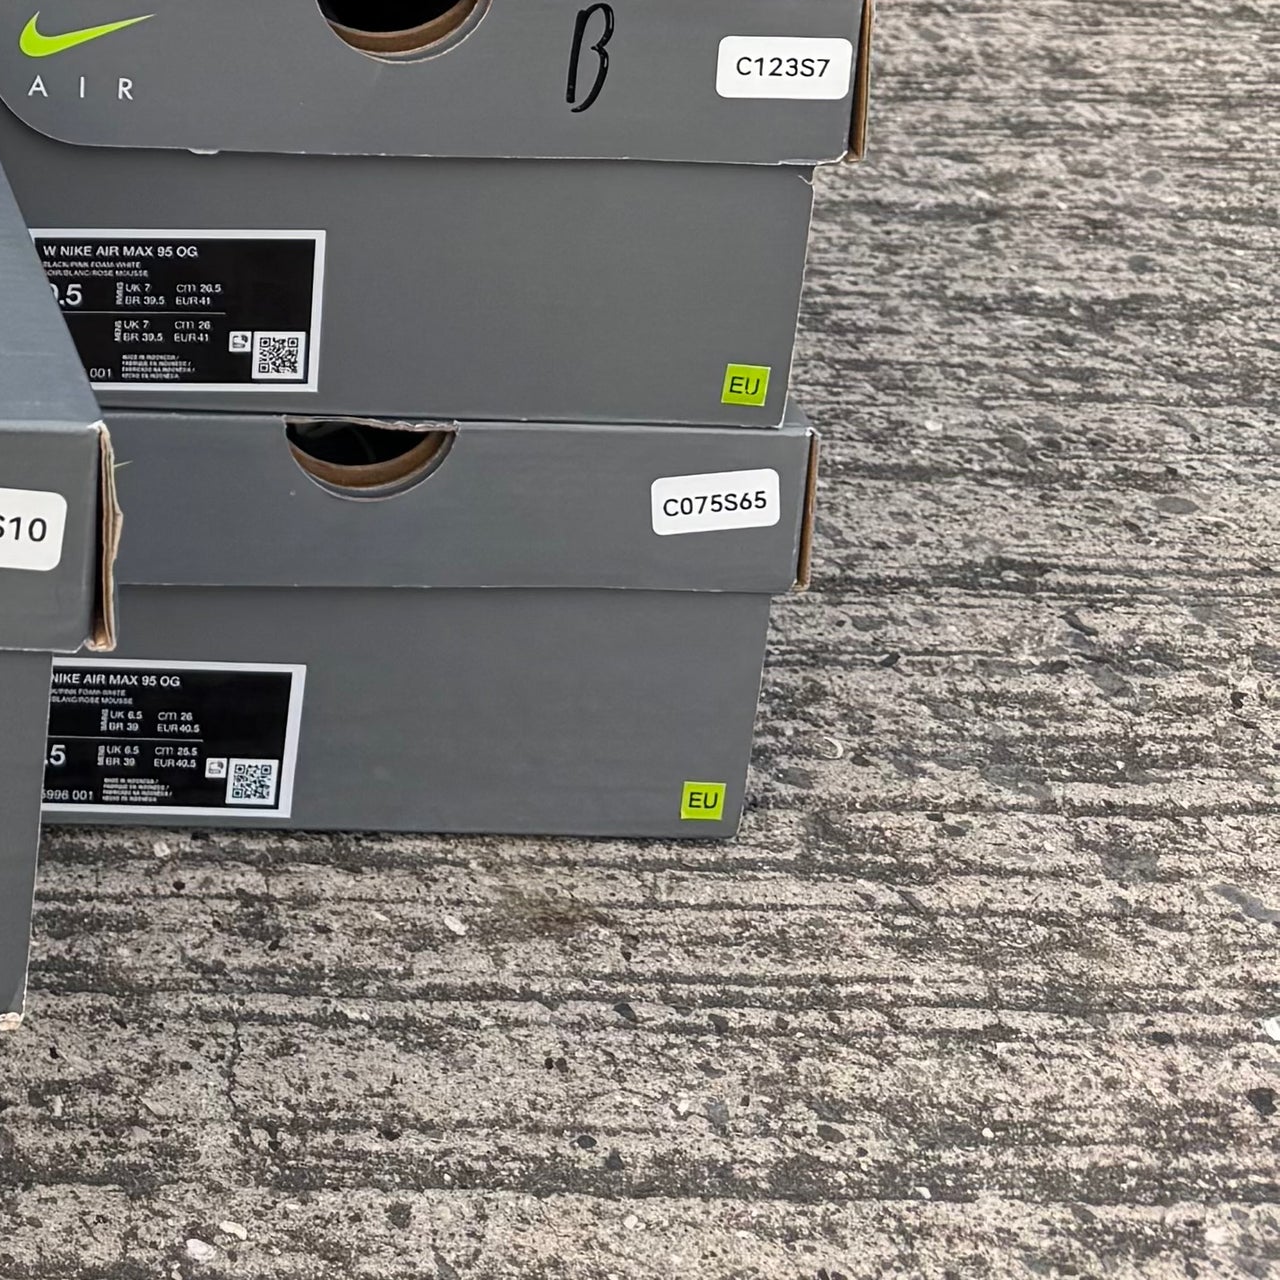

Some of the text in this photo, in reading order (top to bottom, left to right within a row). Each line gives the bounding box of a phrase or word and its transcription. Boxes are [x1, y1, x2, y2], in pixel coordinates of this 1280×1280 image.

[564, 2, 616, 114] B
[736, 56, 831, 78] C123S7
[28, 75, 133, 100] AIR
[43, 246, 198, 258] W NIKE AIR MAX 95 OG
[90, 368, 112, 378] 001
[729, 377, 761, 396] EU
[663, 490, 767, 517] C075S65
[51, 673, 181, 687] NIKE AIR MAX 95 OG
[72, 791, 93, 801] 001
[688, 792, 718, 809] EU
